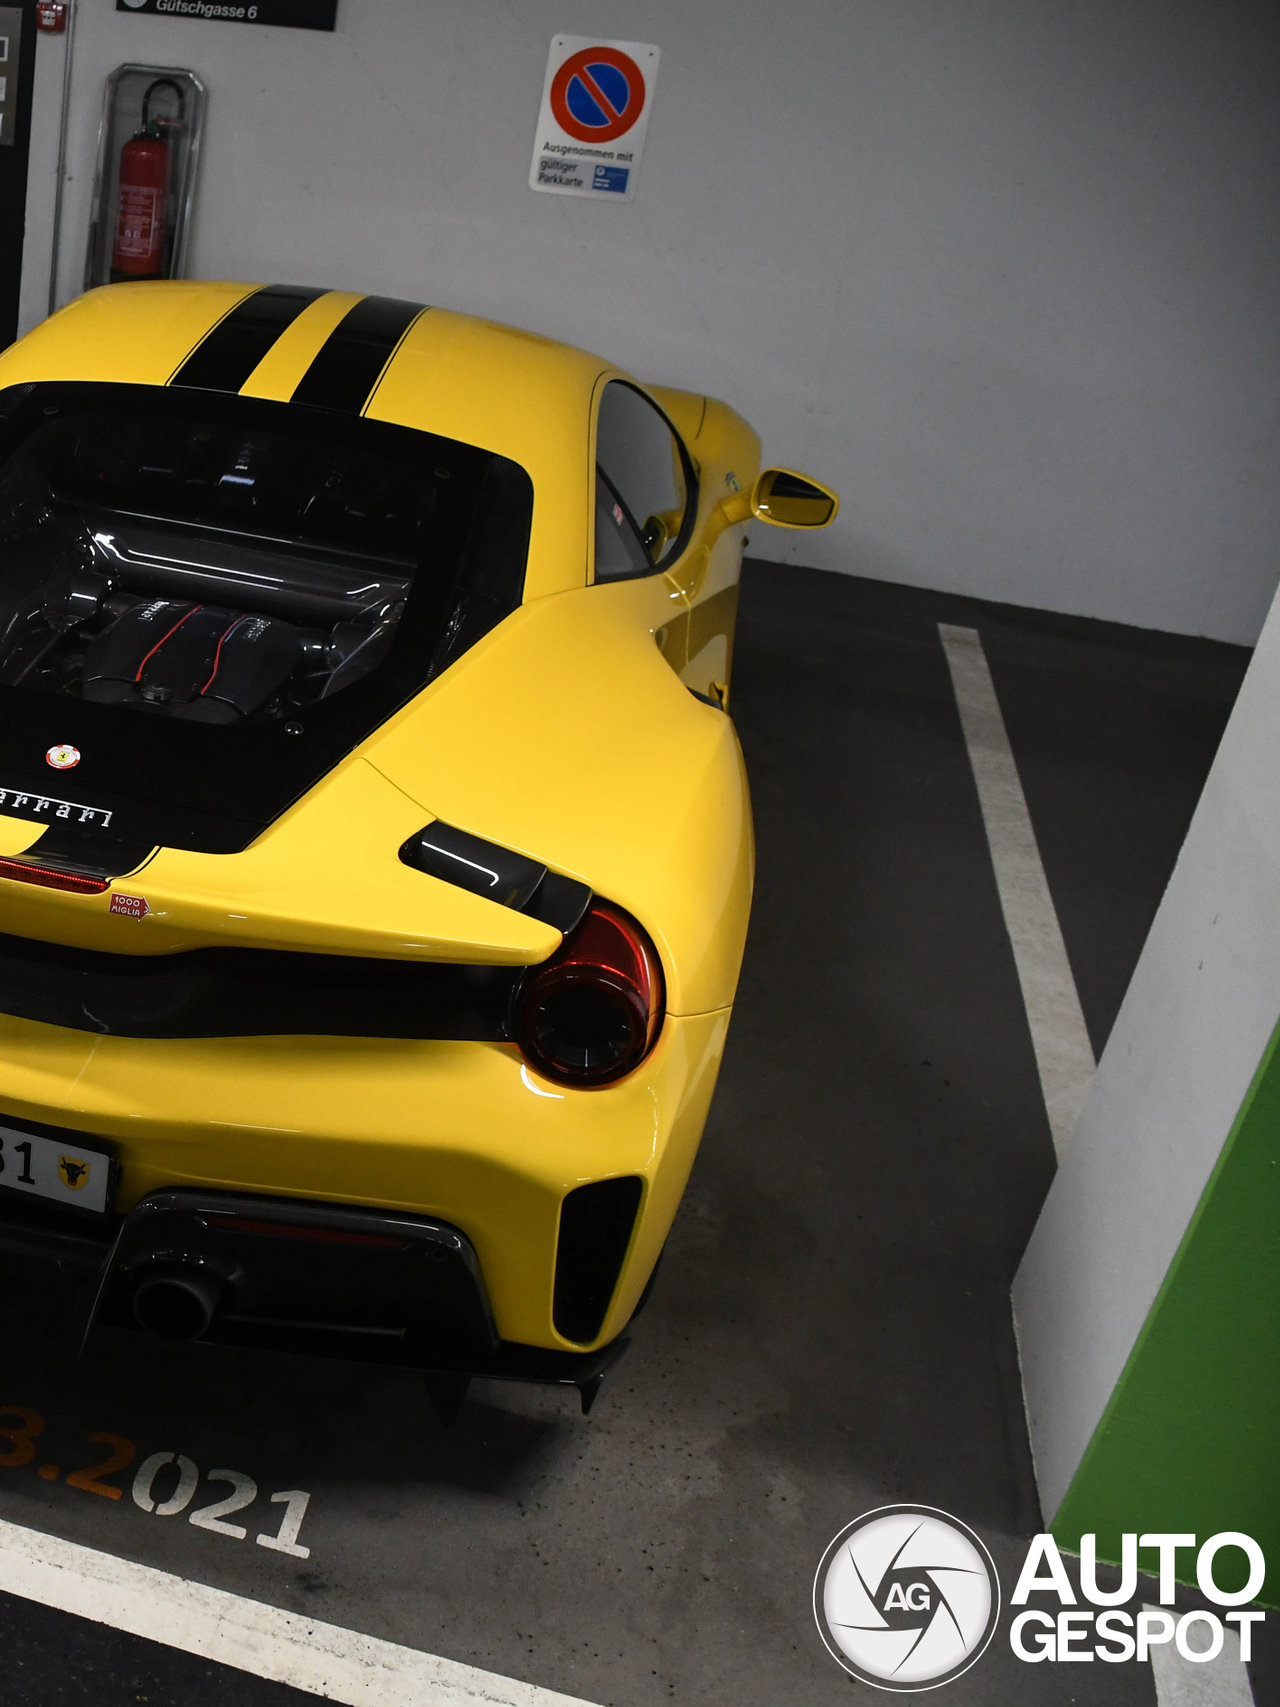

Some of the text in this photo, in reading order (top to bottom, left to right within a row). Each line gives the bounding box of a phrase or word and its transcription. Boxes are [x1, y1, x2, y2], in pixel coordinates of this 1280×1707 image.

[246, 6, 258, 19] 6
[543, 141, 633, 162] Ausgenommen mit
[540, 159, 578, 173] gültiger
[538, 172, 583, 187] Parkkarte
[115, 896, 140, 907] 1000
[111, 905, 140, 917] MIGLIA
